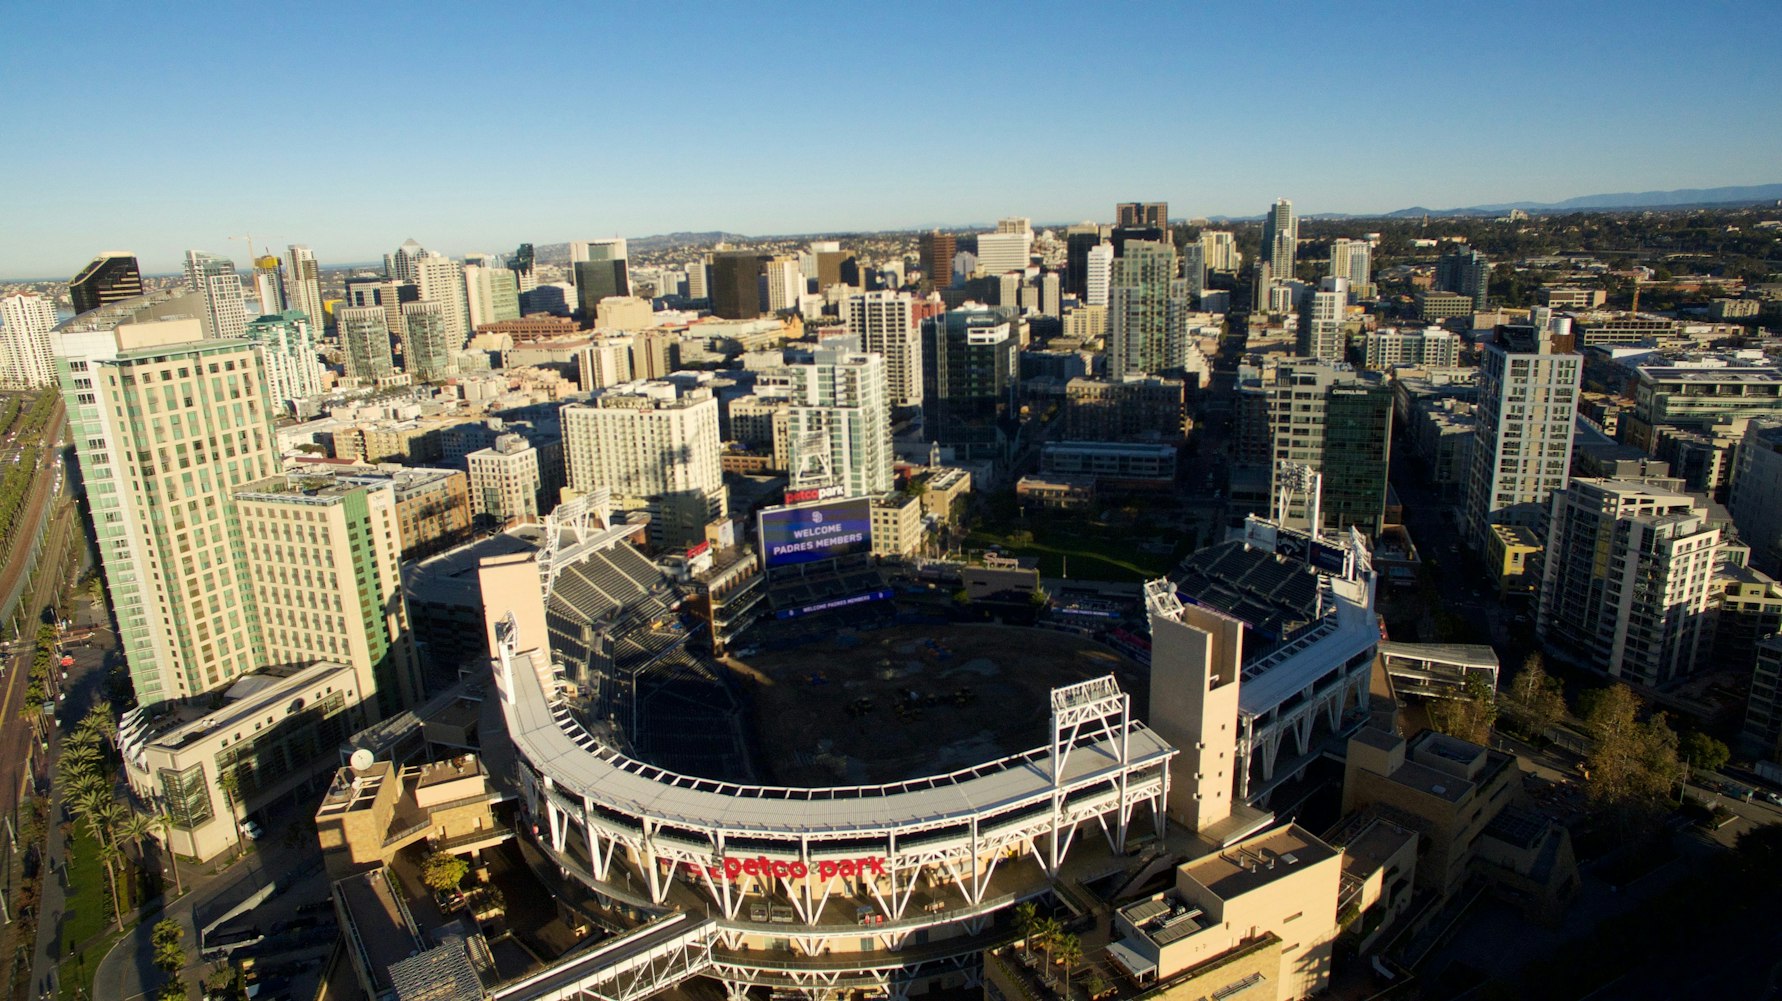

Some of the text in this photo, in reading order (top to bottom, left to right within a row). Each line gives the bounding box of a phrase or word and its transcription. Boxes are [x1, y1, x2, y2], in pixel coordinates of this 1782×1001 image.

[793, 523, 842, 539] WELCOME
[773, 533, 863, 555] PADRES MEMBERS
[802, 603, 827, 613] WELCOME
[723, 855, 808, 881] petco
[818, 855, 887, 883] park
